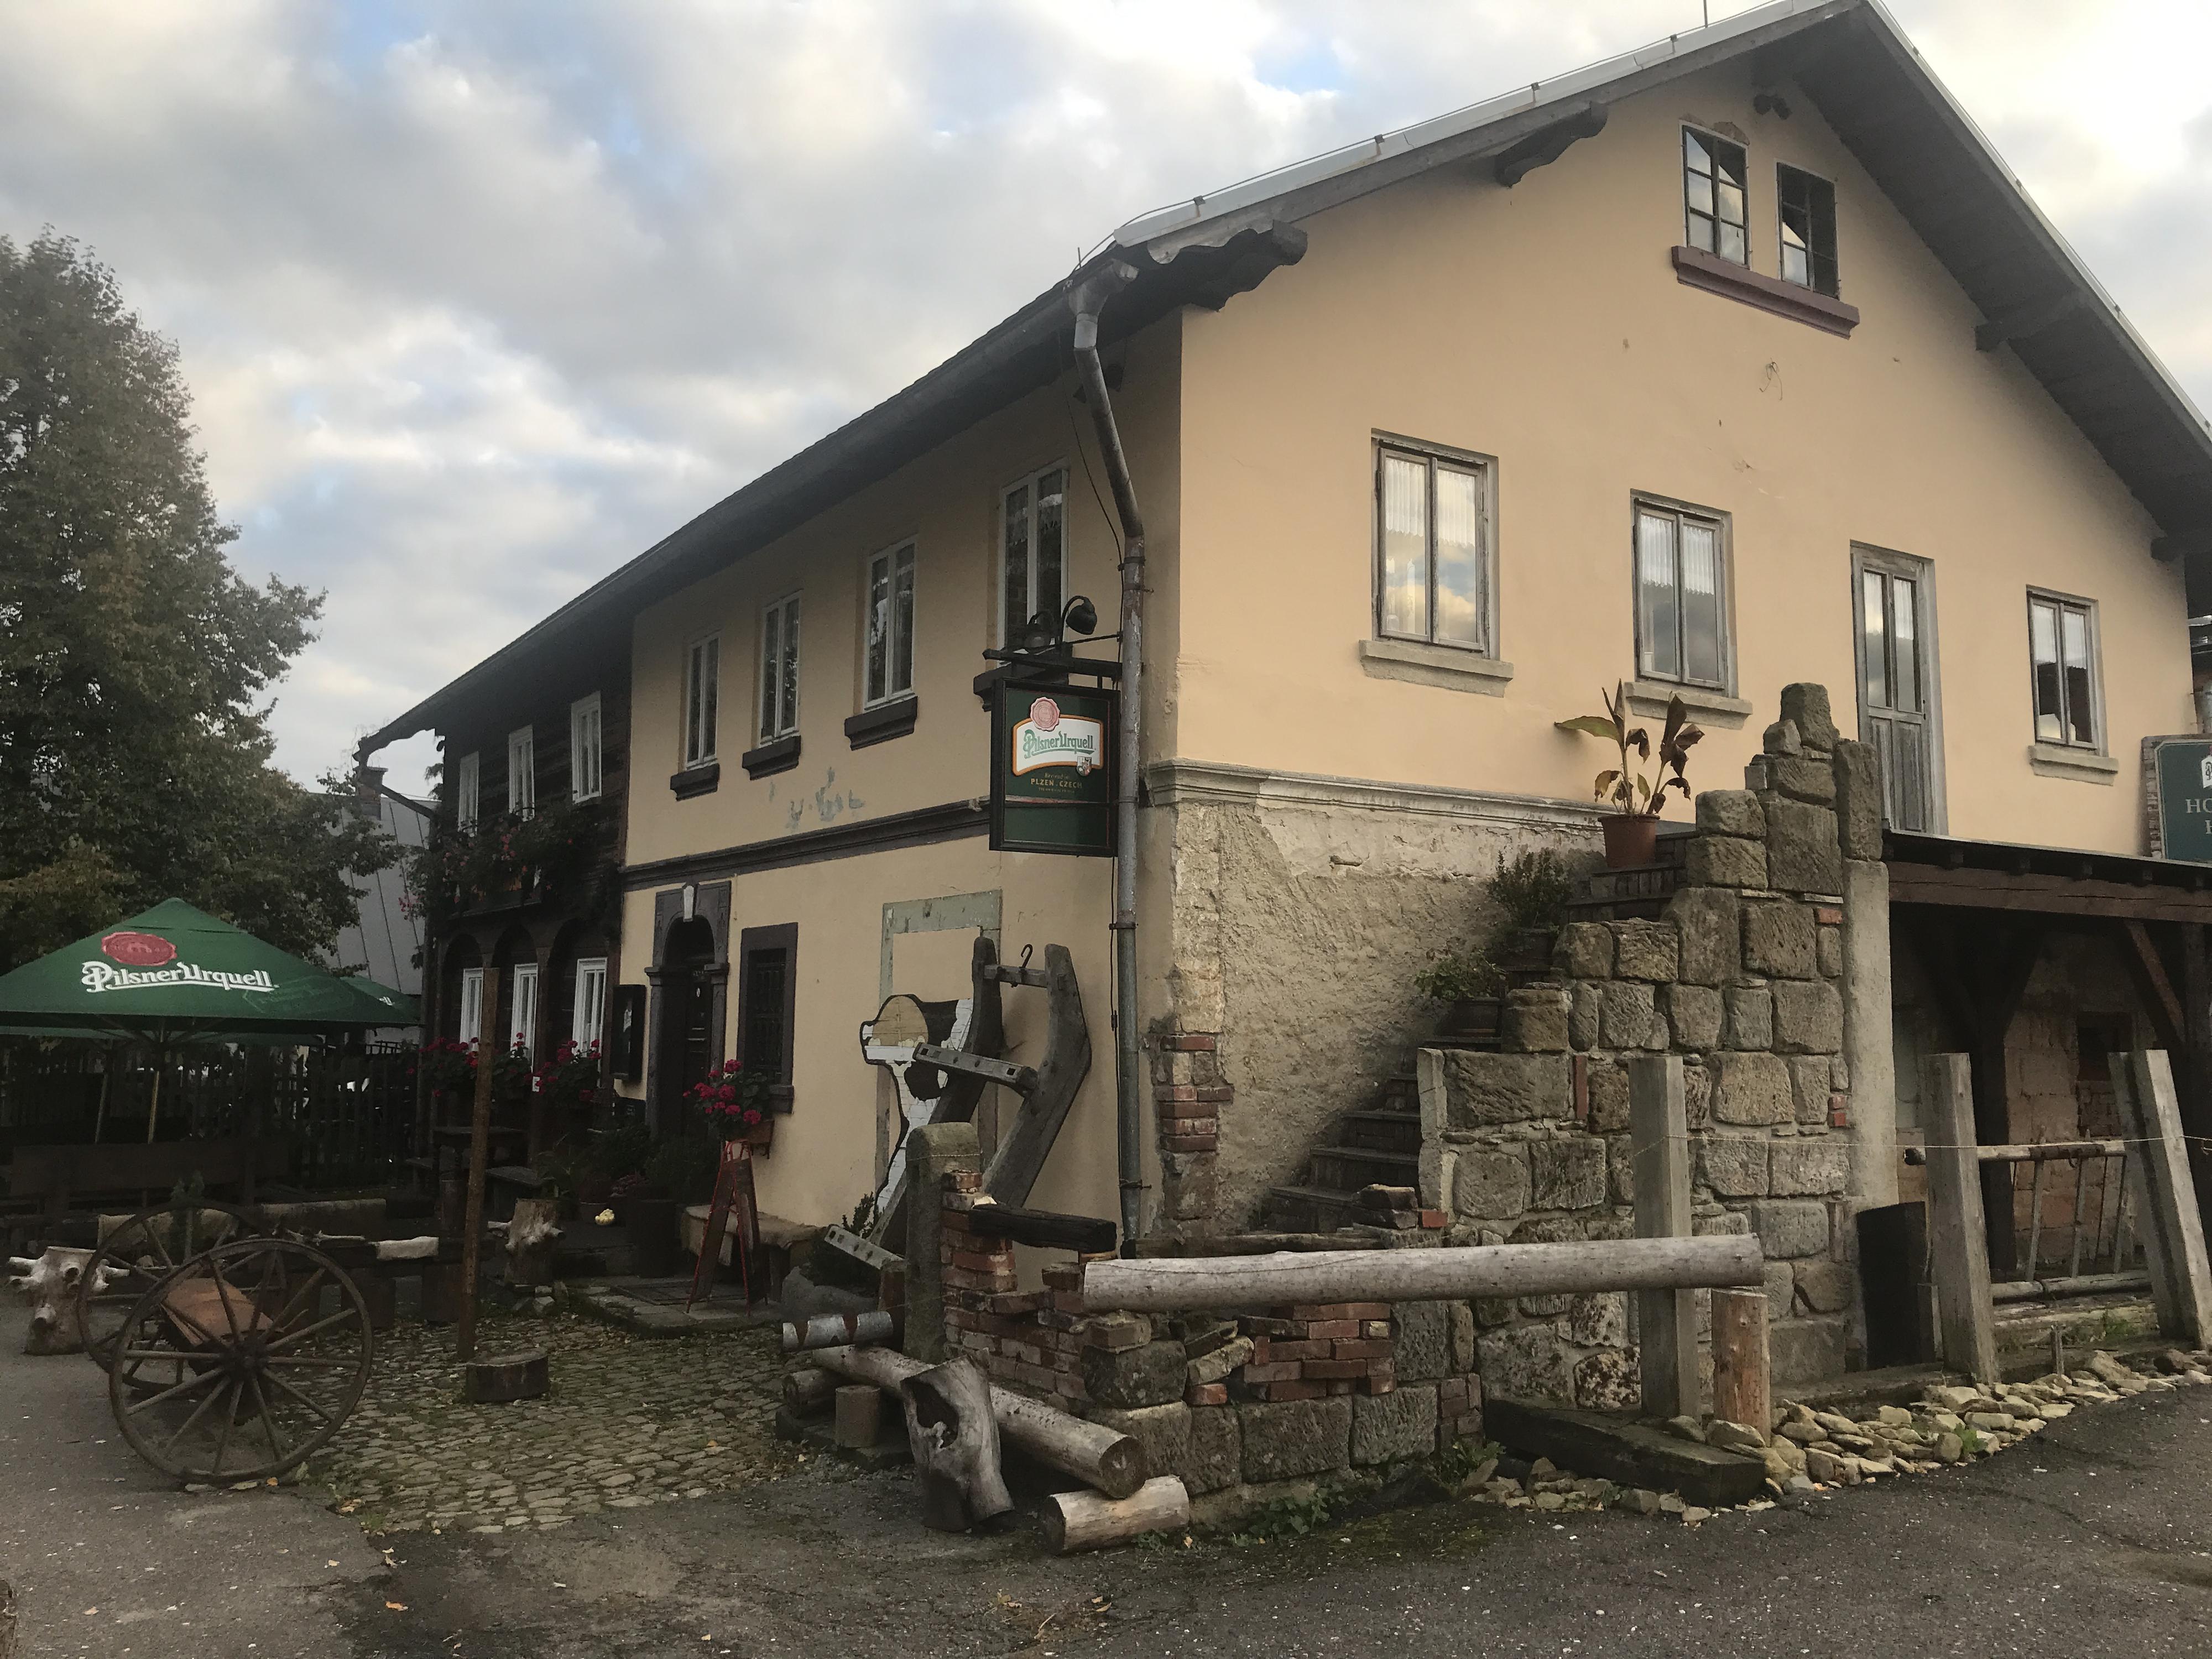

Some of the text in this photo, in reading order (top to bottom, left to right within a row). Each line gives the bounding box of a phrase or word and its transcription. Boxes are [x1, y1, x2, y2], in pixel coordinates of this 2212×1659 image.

[1023, 729, 1093, 759] Pilsner Urquell
[82, 961, 273, 993] Pilsner Urquell
